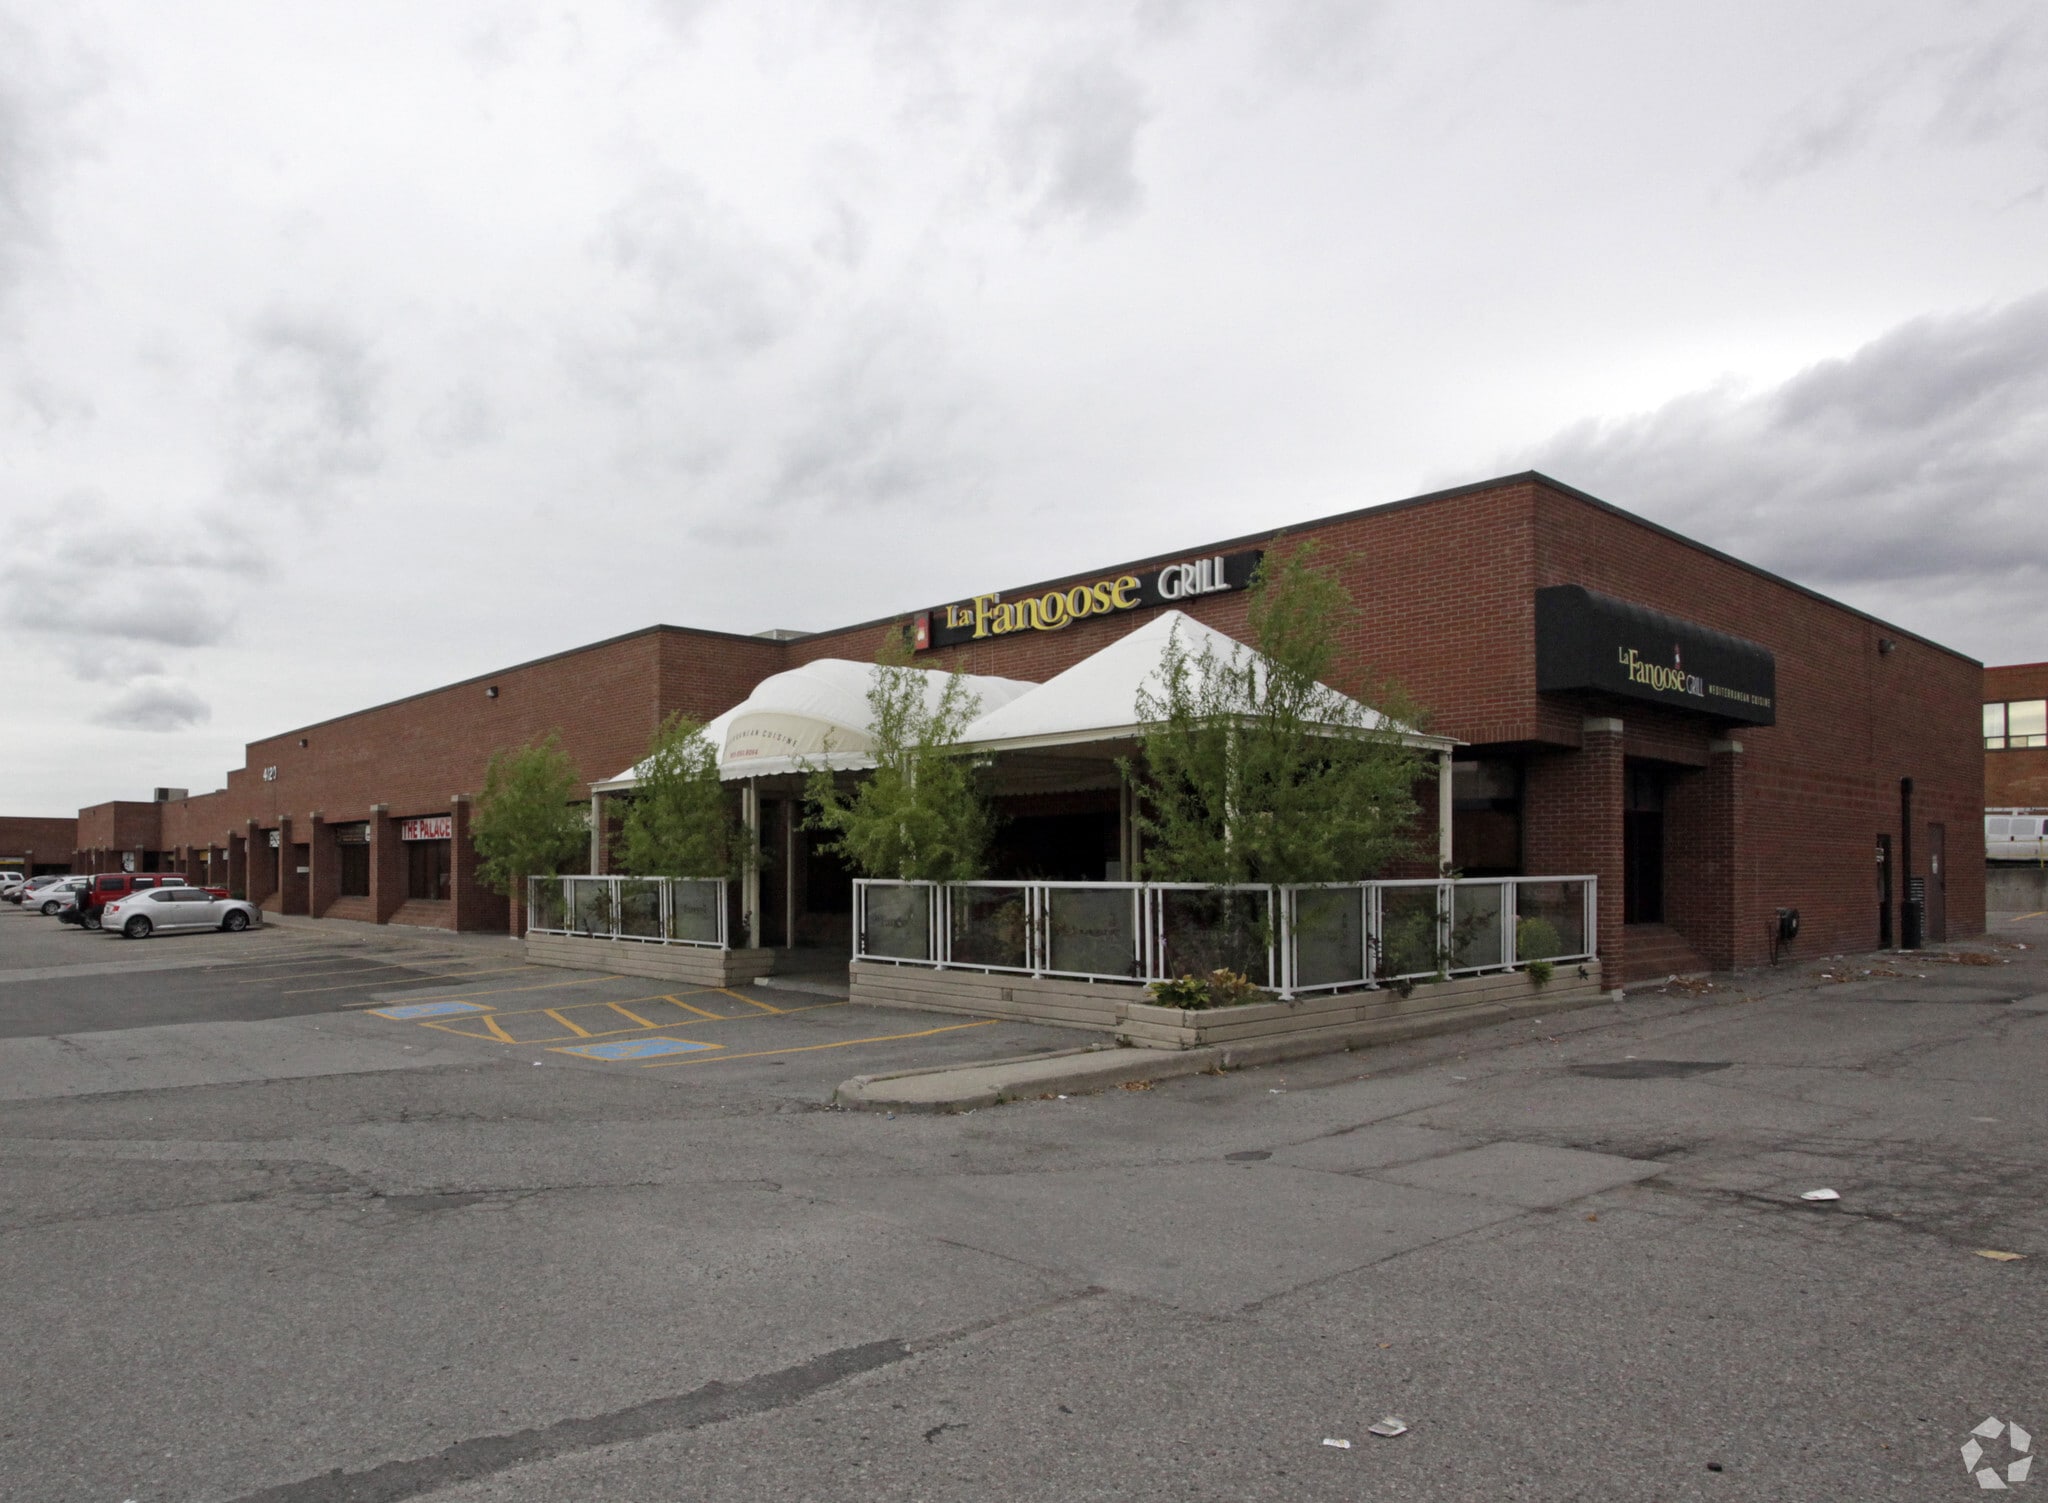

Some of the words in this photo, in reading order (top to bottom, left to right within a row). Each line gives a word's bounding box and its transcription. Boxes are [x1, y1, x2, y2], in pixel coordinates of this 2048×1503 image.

[946, 604, 975, 630] La
[972, 575, 1142, 639] Fanoose
[1157, 556, 1232, 600] GRILL
[1628, 649, 1685, 692] Fanoose
[402, 820, 418, 840] THE
[420, 818, 451, 838] PALACE
